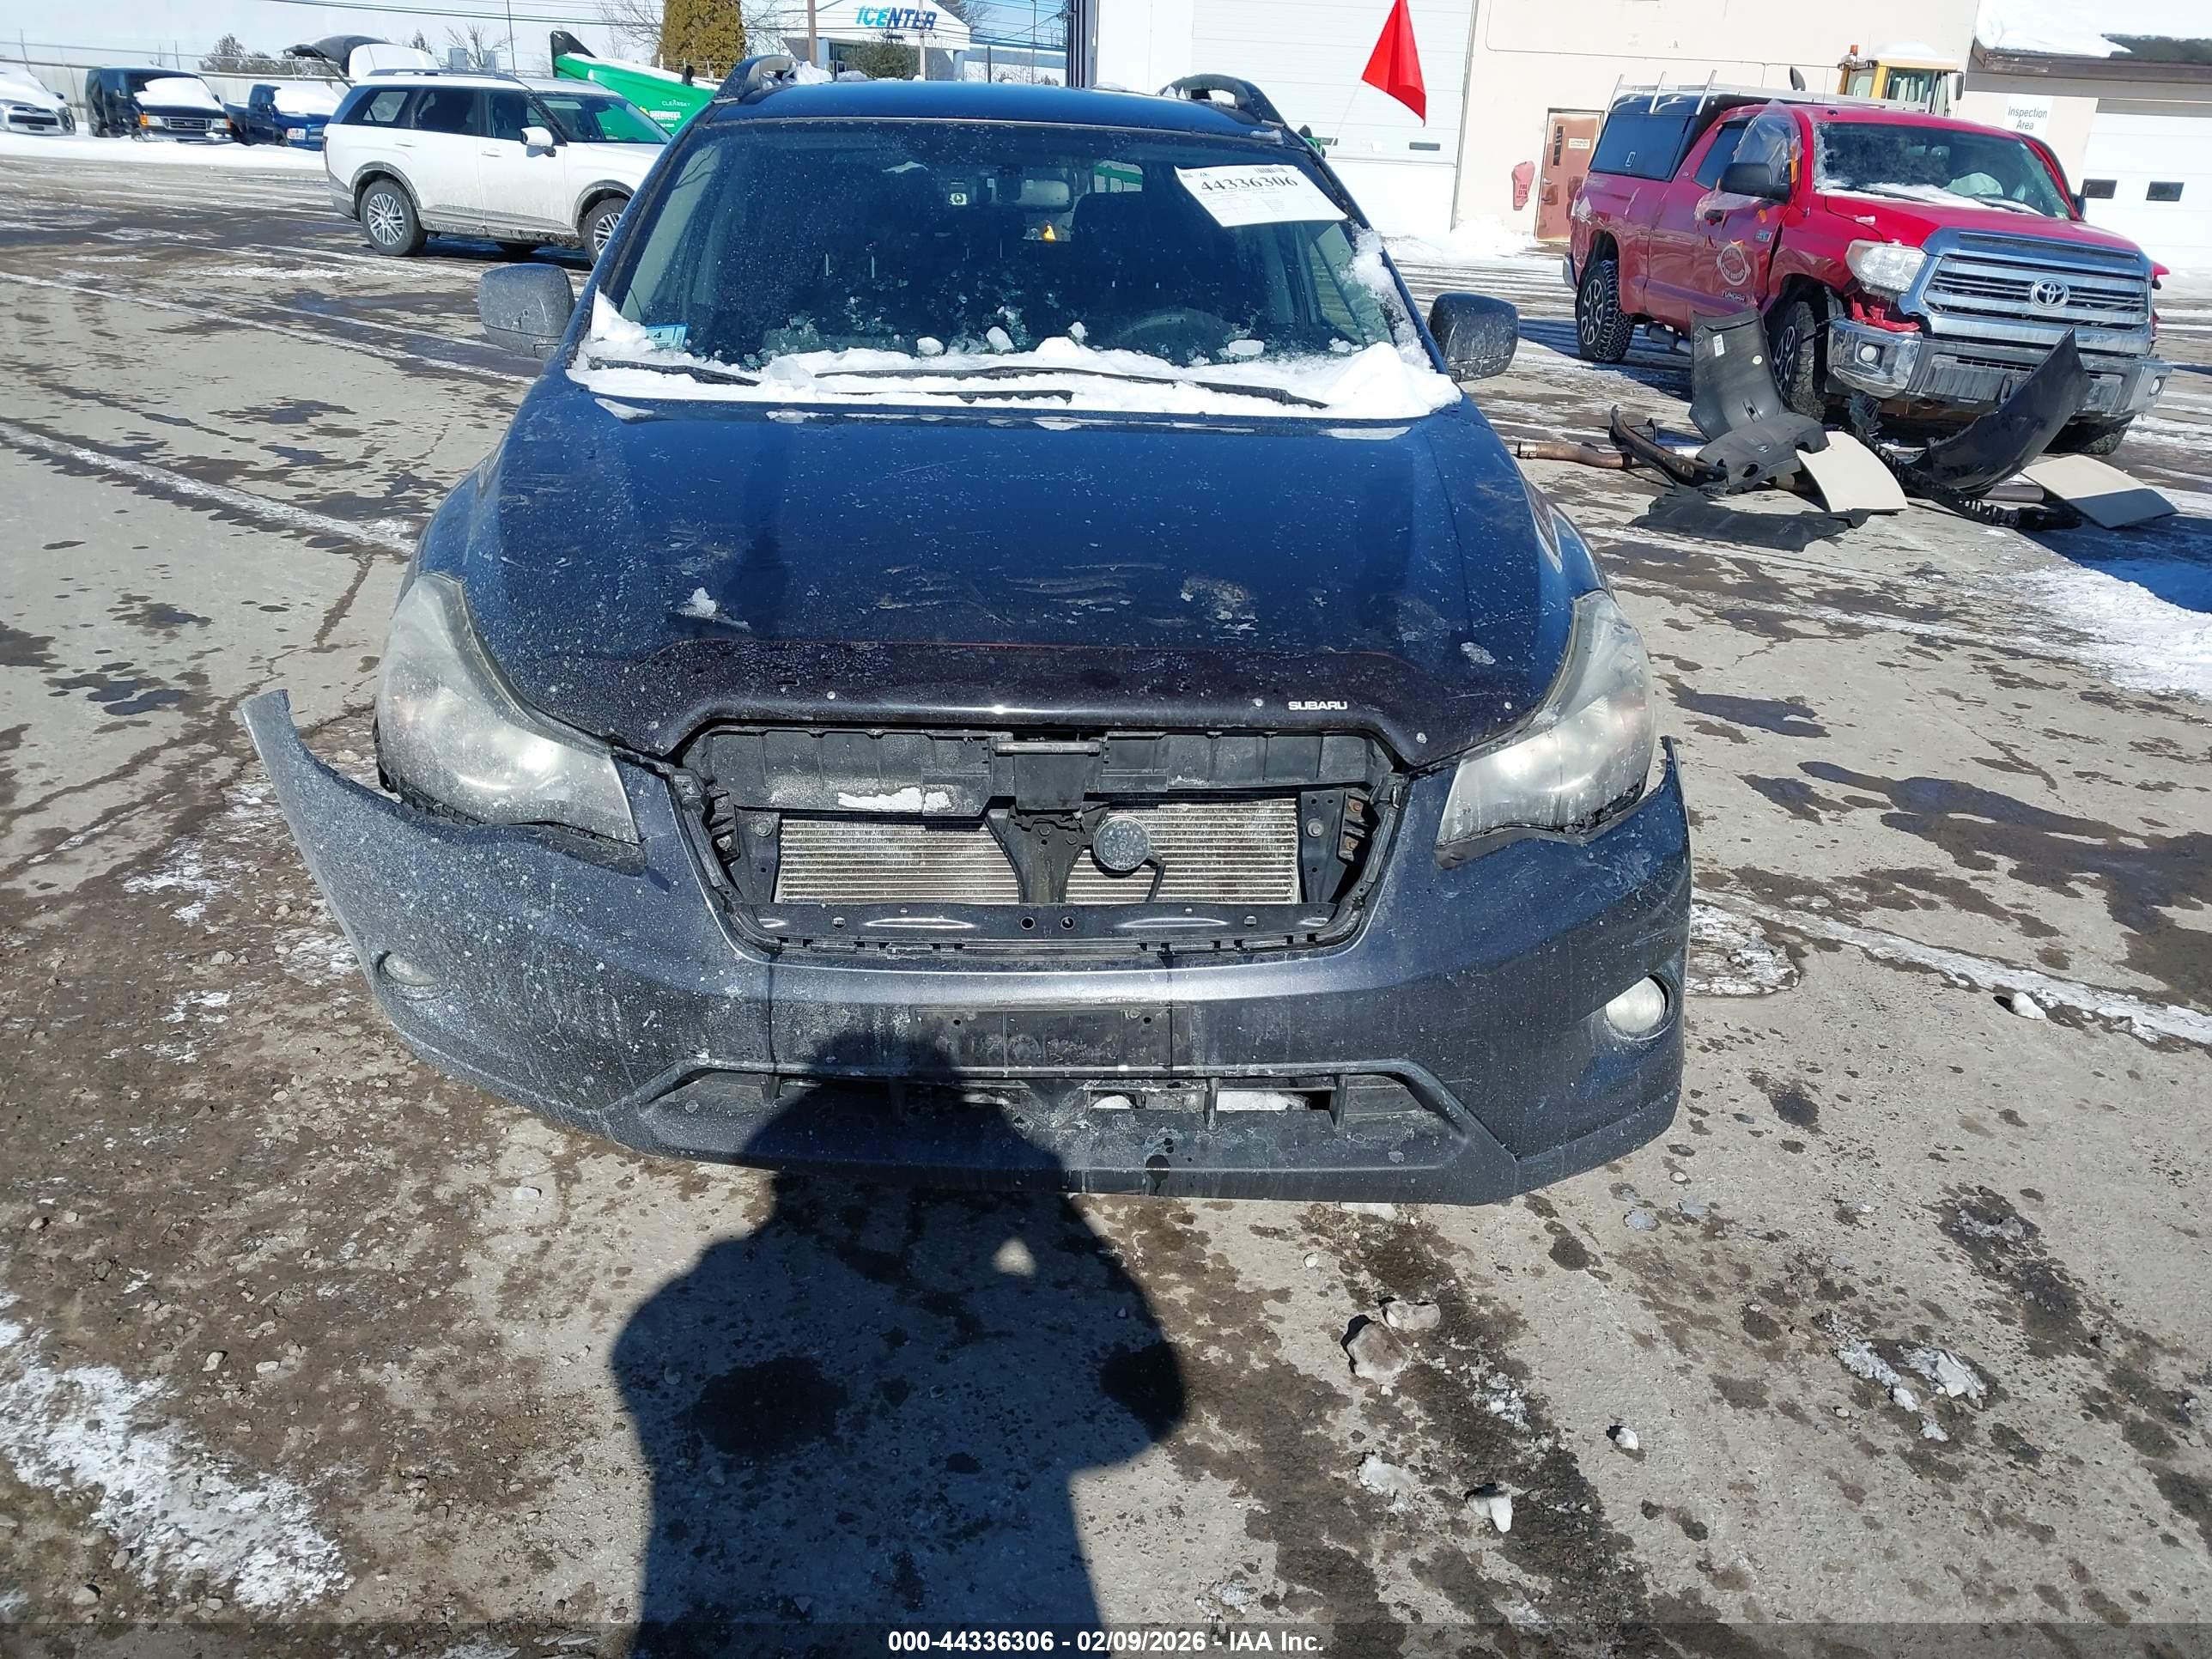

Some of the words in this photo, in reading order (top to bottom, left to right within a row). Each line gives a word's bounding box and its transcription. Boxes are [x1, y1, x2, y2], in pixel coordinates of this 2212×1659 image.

[855, 6, 938, 30] ICENTER
[2008, 106, 2048, 118] Inspection
[2015, 119, 2034, 130] Area
[1201, 176, 1298, 191] 44336306
[1288, 701, 1348, 710] SUBARU
